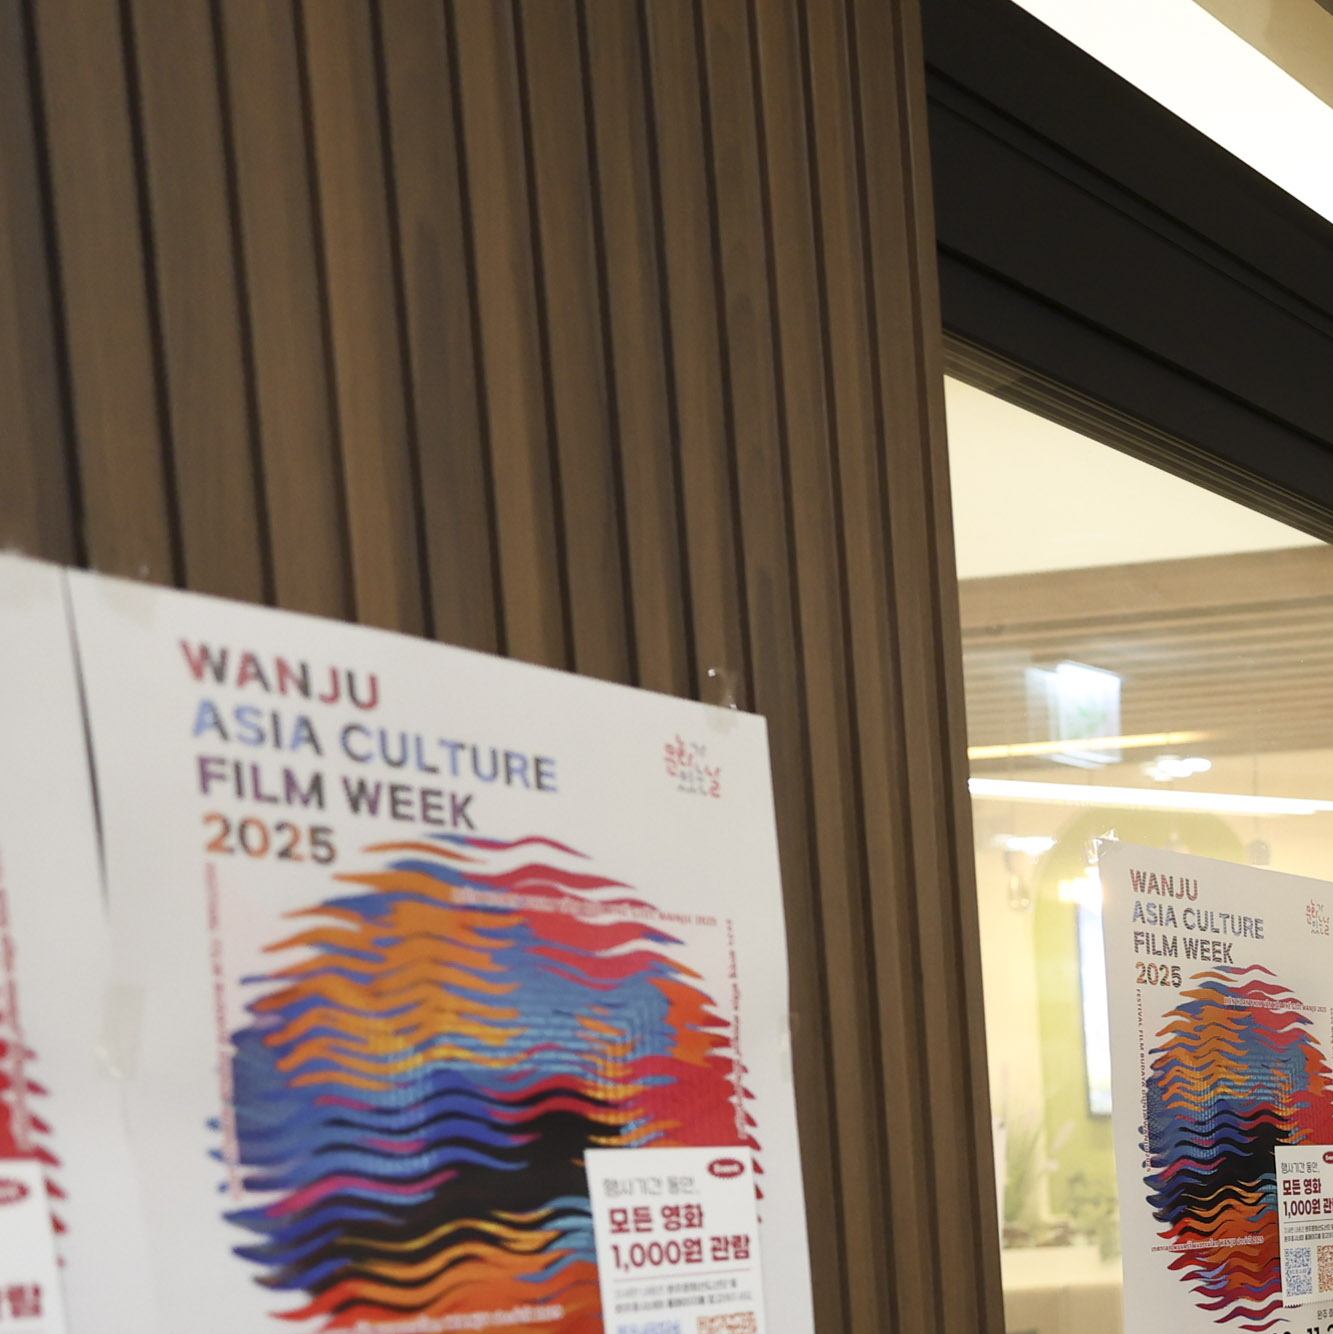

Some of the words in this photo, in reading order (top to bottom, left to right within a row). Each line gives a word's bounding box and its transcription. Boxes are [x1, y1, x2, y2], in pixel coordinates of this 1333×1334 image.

[180, 638, 380, 711] WANJU
[192, 698, 323, 756] ASIA
[340, 722, 558, 793] CULTURE
[196, 754, 326, 810] FILM
[343, 775, 477, 831] WEEK
[202, 812, 337, 865] 2025
[1129, 868, 1198, 902] WANJU
[1132, 900, 1178, 928] ASIA
[1182, 906, 1264, 940] CULTURE
[1133, 930, 1179, 958] FILM
[1183, 937, 1234, 965] WEEK
[1135, 961, 1182, 989] 2025
[1281, 1161, 1305, 1174] 행사기간
[1282, 1179, 1301, 1196] 모든
[1303, 1177, 1321, 1195] 영화
[609, 1206, 653, 1235] 모든
[661, 1203, 704, 1232] 영화
[1283, 1198, 1321, 1218] 1,000원
[611, 1237, 703, 1273] 1,000원
[710, 1233, 750, 1262] 관람
